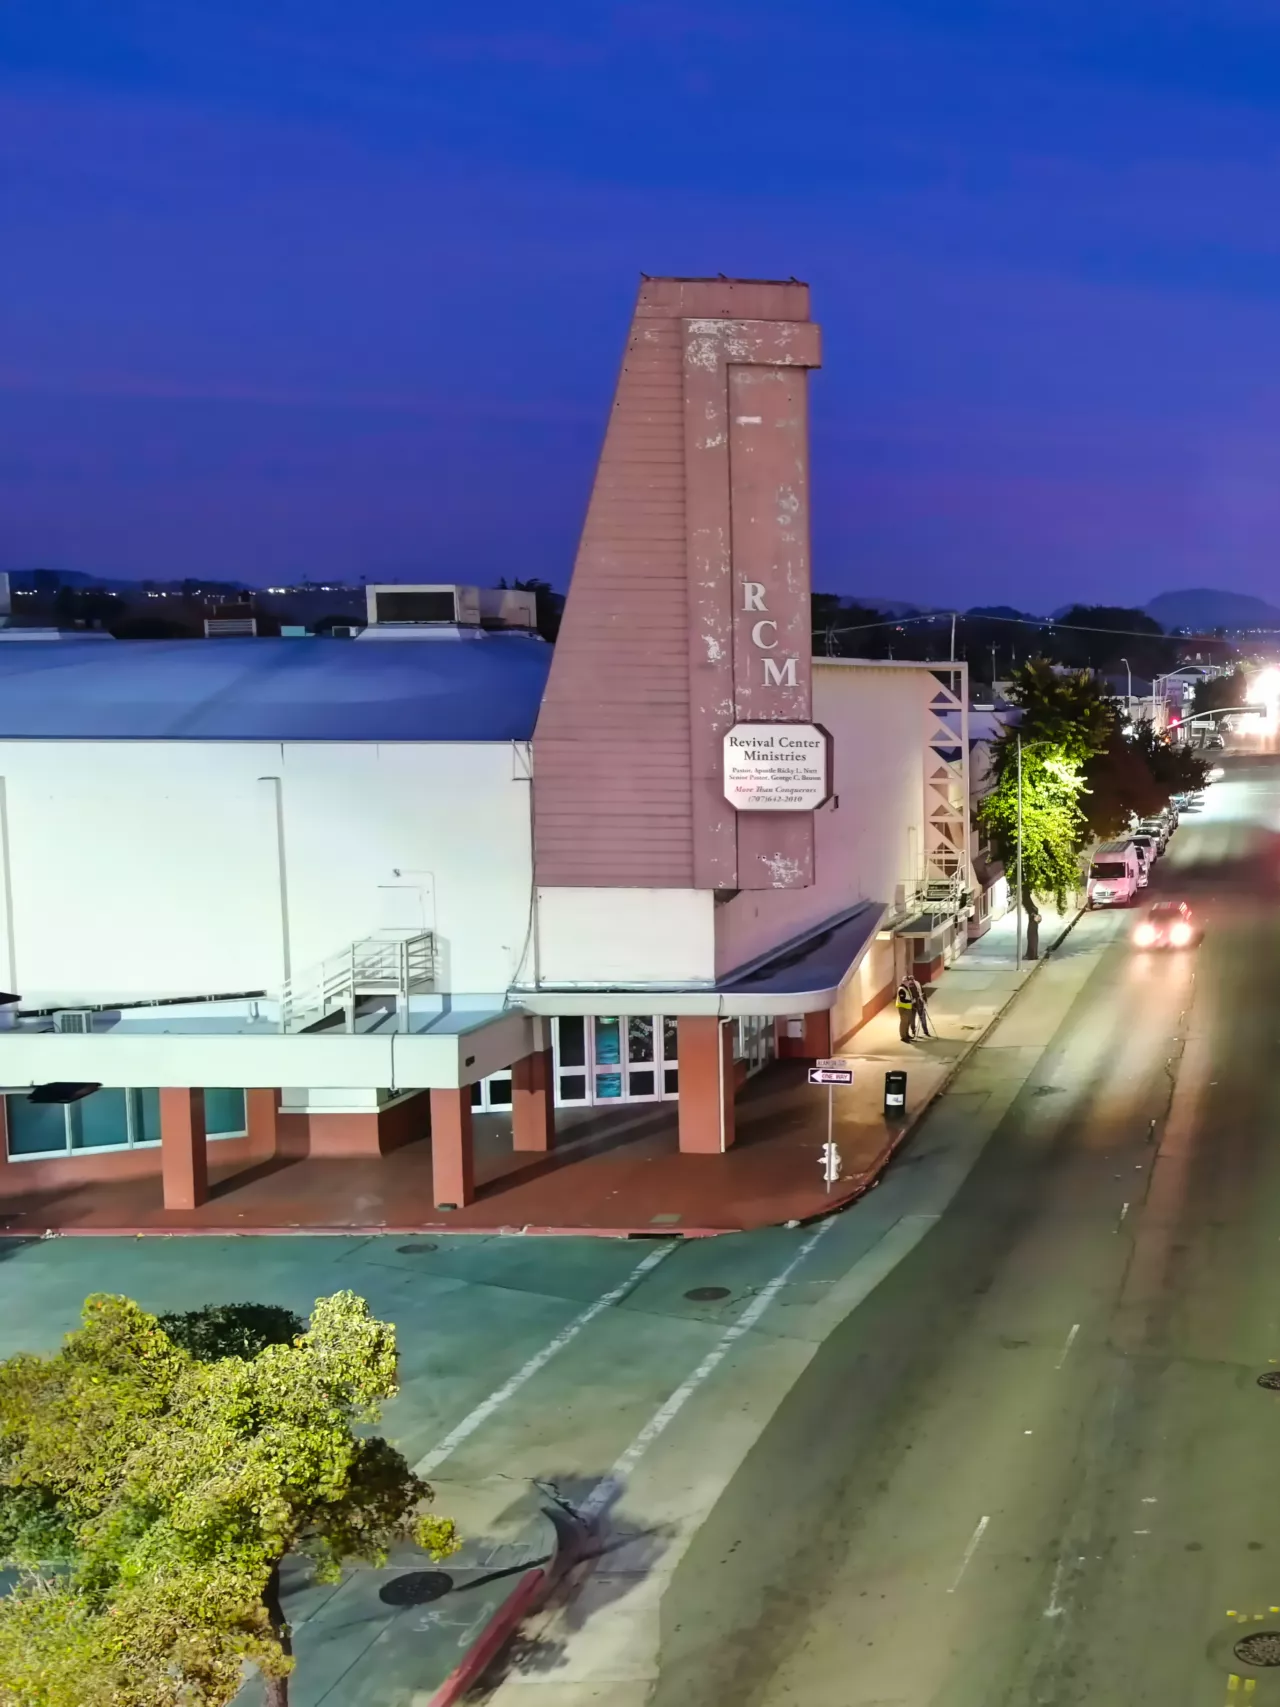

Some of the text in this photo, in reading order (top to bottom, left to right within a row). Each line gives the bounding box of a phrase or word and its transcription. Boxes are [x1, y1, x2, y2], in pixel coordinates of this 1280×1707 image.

[729, 736, 820, 748] Revival Center
[744, 750, 806, 761] Ministries
[775, 786, 816, 795] Conquerors
